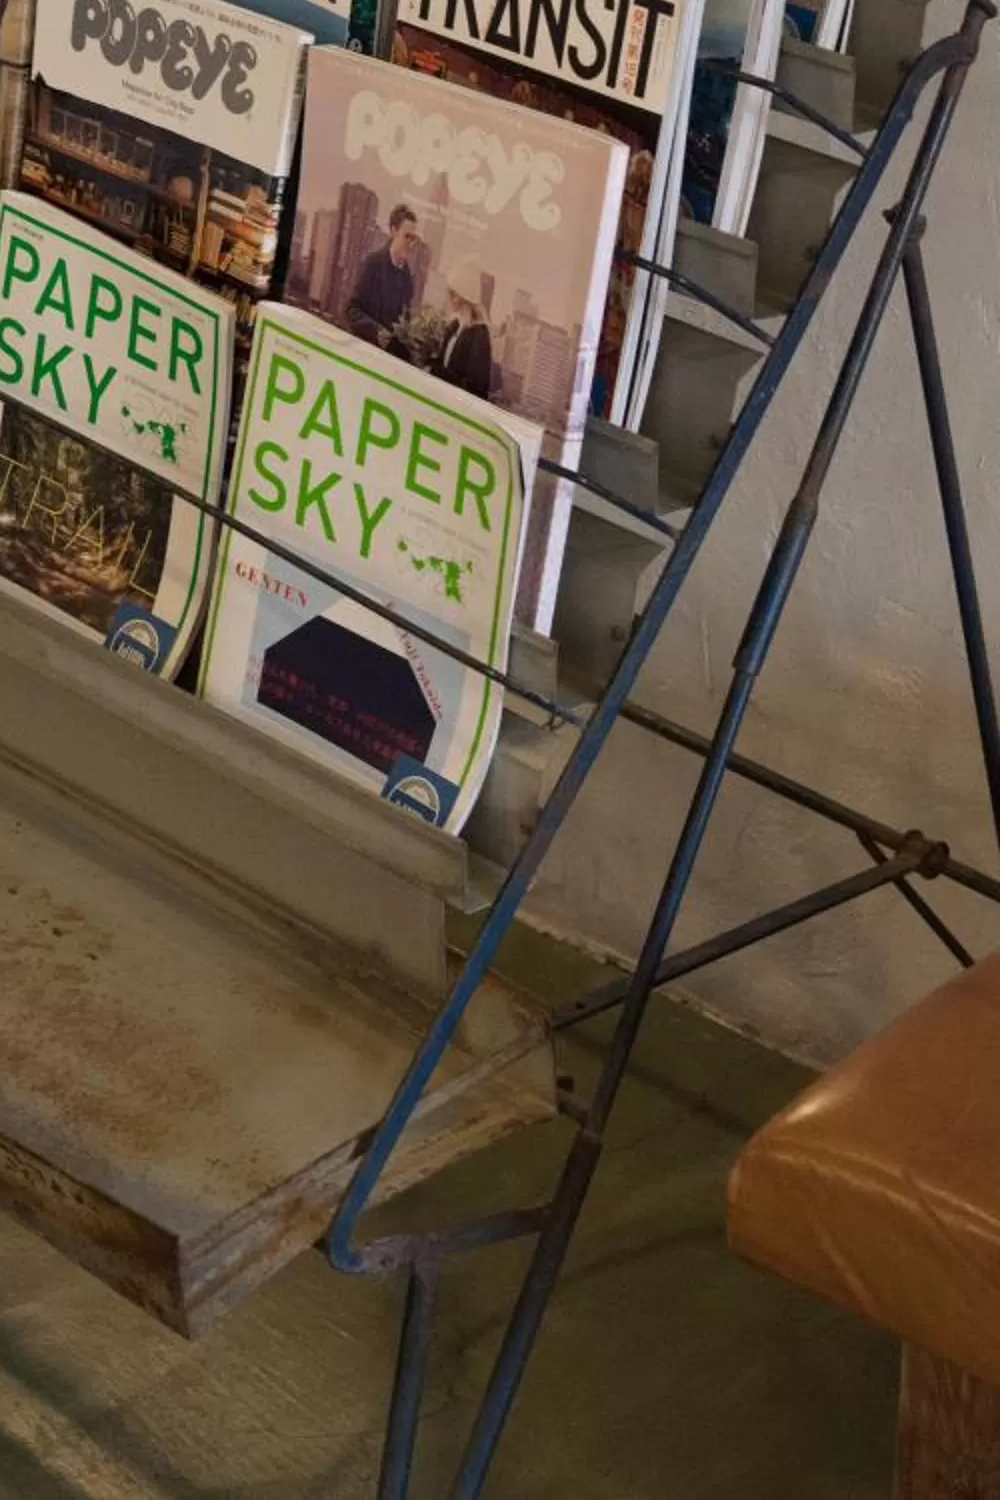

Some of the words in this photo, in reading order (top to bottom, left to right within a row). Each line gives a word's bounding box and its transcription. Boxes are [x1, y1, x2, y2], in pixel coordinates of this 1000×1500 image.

[344, 90, 565, 231] POPEYE
[1, 235, 204, 395] PAPER
[247, 440, 392, 559] SKY
[262, 353, 496, 533] PAPER
